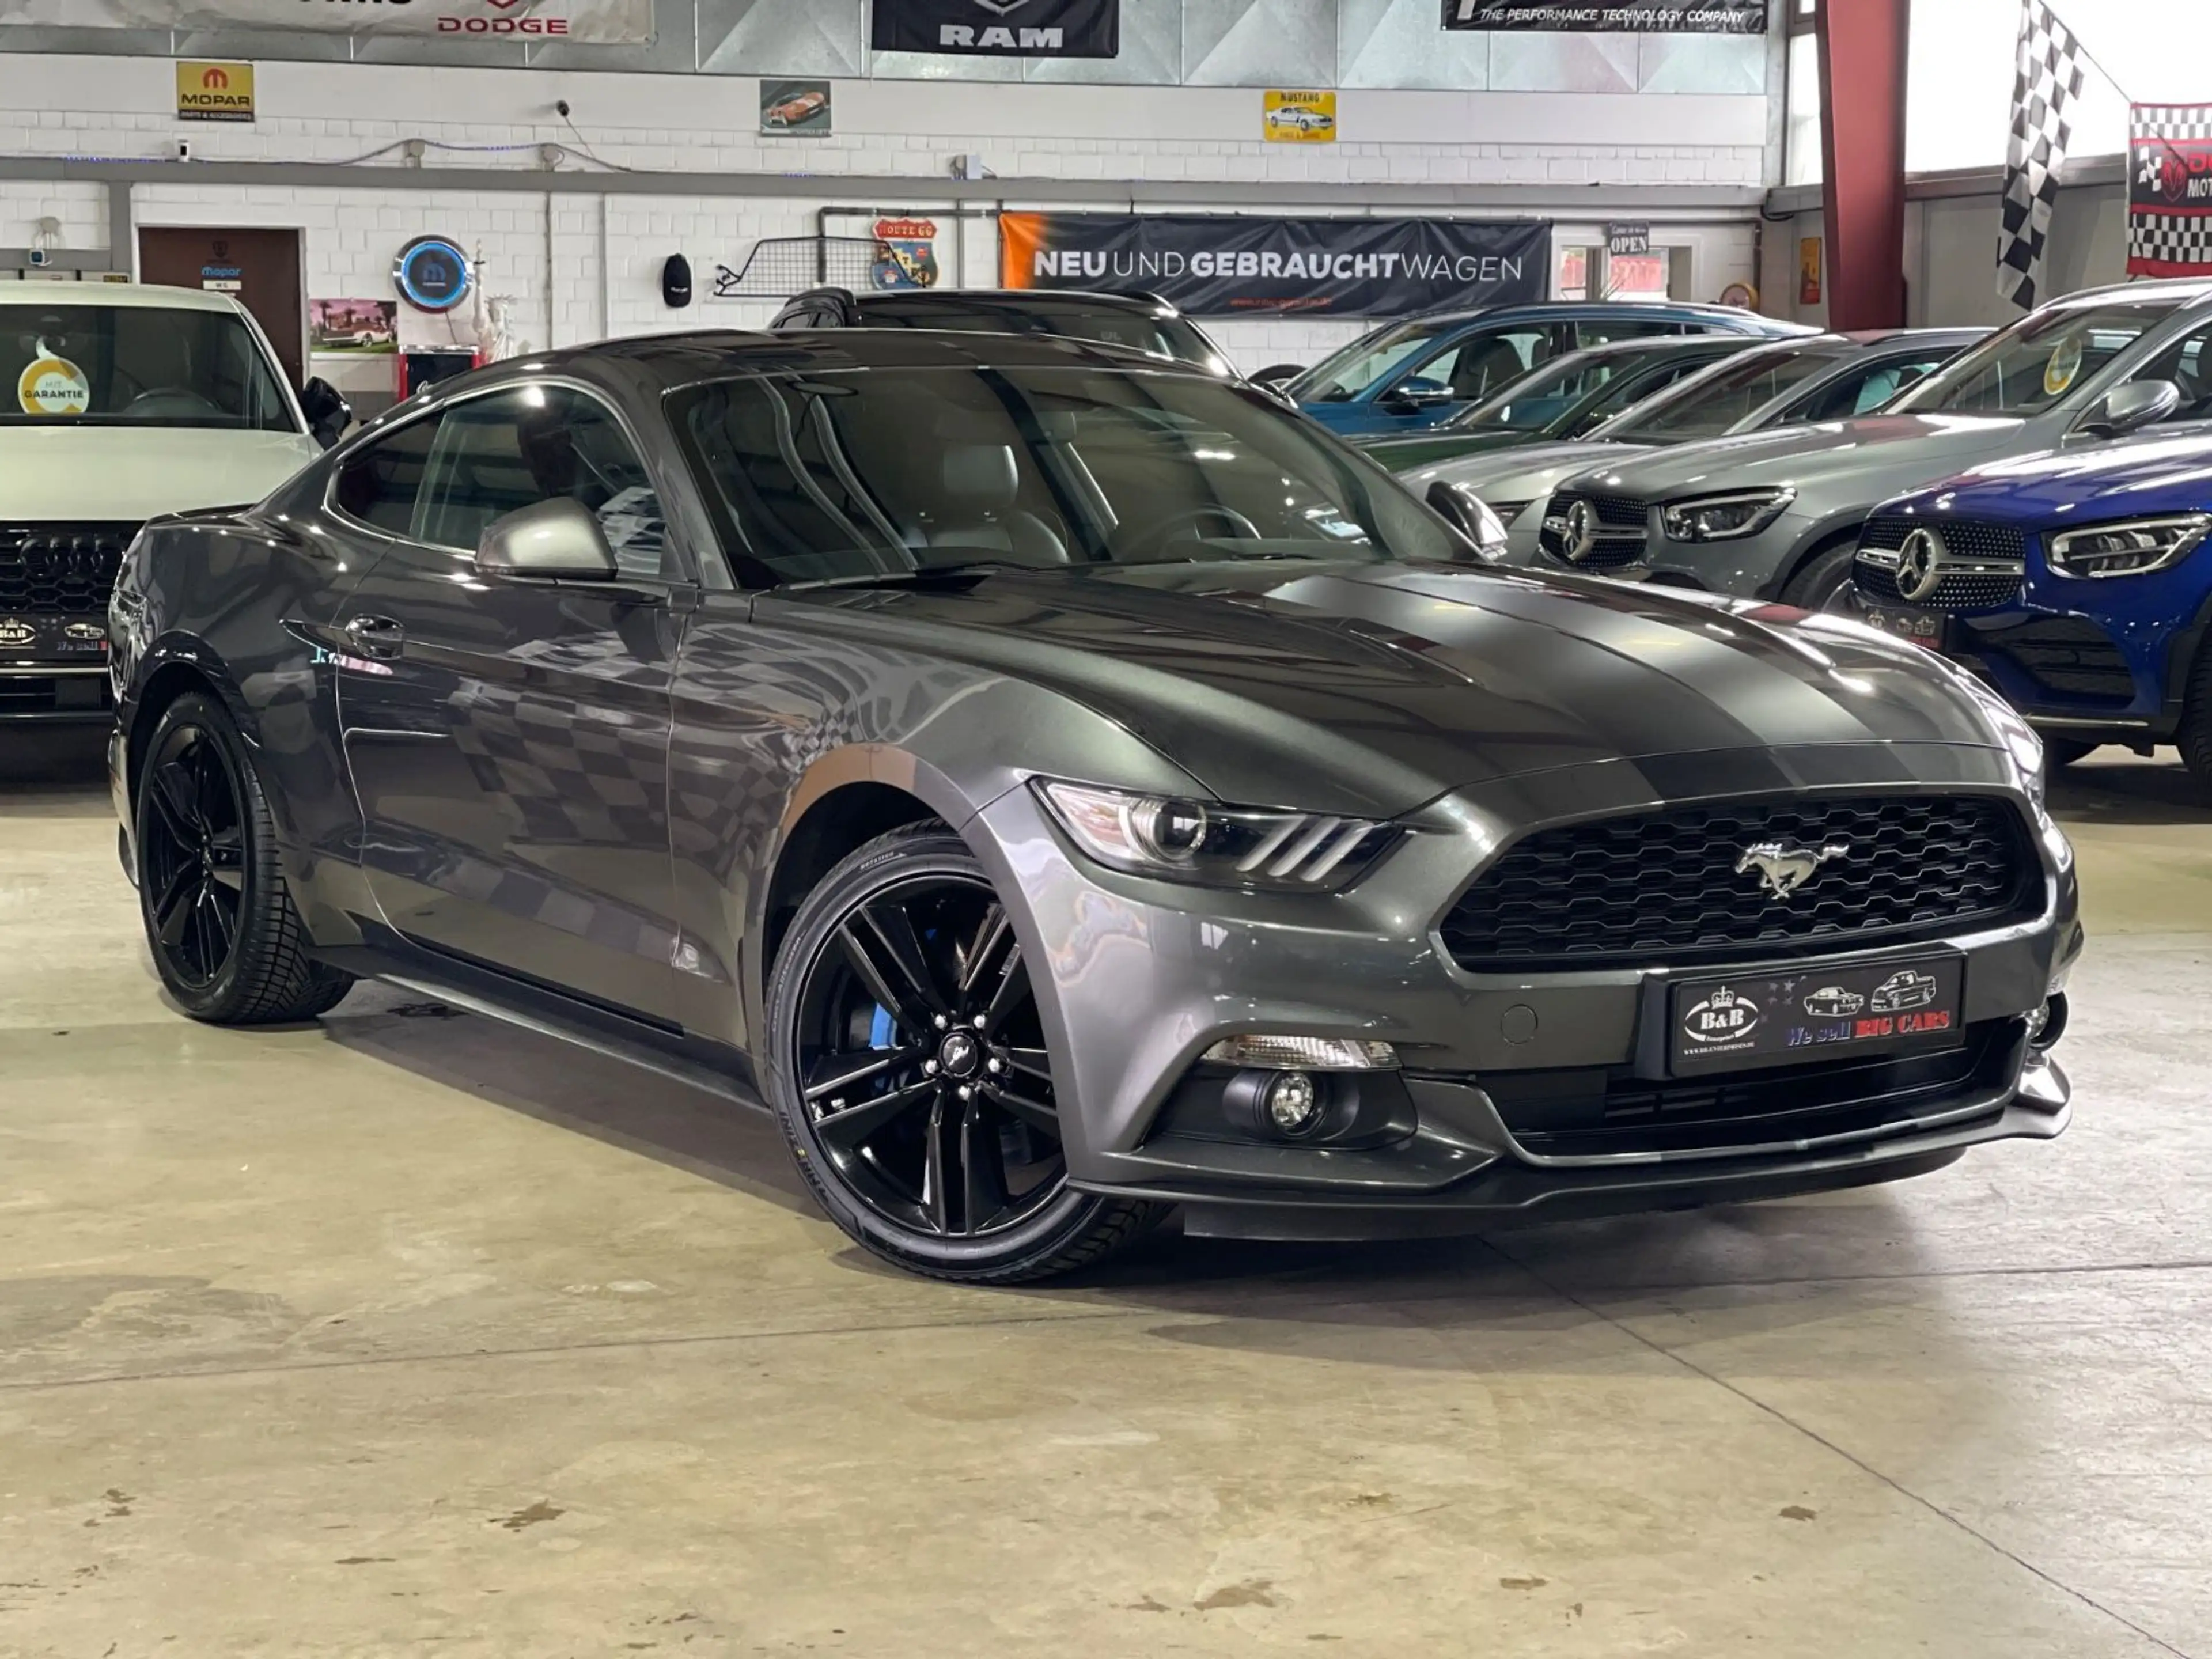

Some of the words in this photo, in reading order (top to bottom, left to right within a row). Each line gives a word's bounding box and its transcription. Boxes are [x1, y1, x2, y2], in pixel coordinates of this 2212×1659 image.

[1479, 8, 1504, 20] THE
[1506, 9, 1598, 21] PERFORMANCE
[1601, 9, 1682, 22] TECHNOLOGY
[1686, 10, 1746, 24] COMPANY
[438, 17, 569, 34] DODGE
[940, 24, 1063, 48] RAM
[181, 93, 251, 106] MOPAR
[1611, 236, 1647, 252] OPEN
[1034, 251, 1107, 277] NEU
[1113, 251, 1185, 277] UND
[1190, 252, 1522, 281] GEBRAUCHTWAGEN
[25, 389, 84, 399] GARANTIE
[1700, 1009, 1744, 1030] B&B
[1788, 1027, 1813, 1046] We
[1816, 1021, 1851, 1041] sell
[1855, 1016, 1893, 1038] BIG
[1898, 1010, 1950, 1033] CARS
